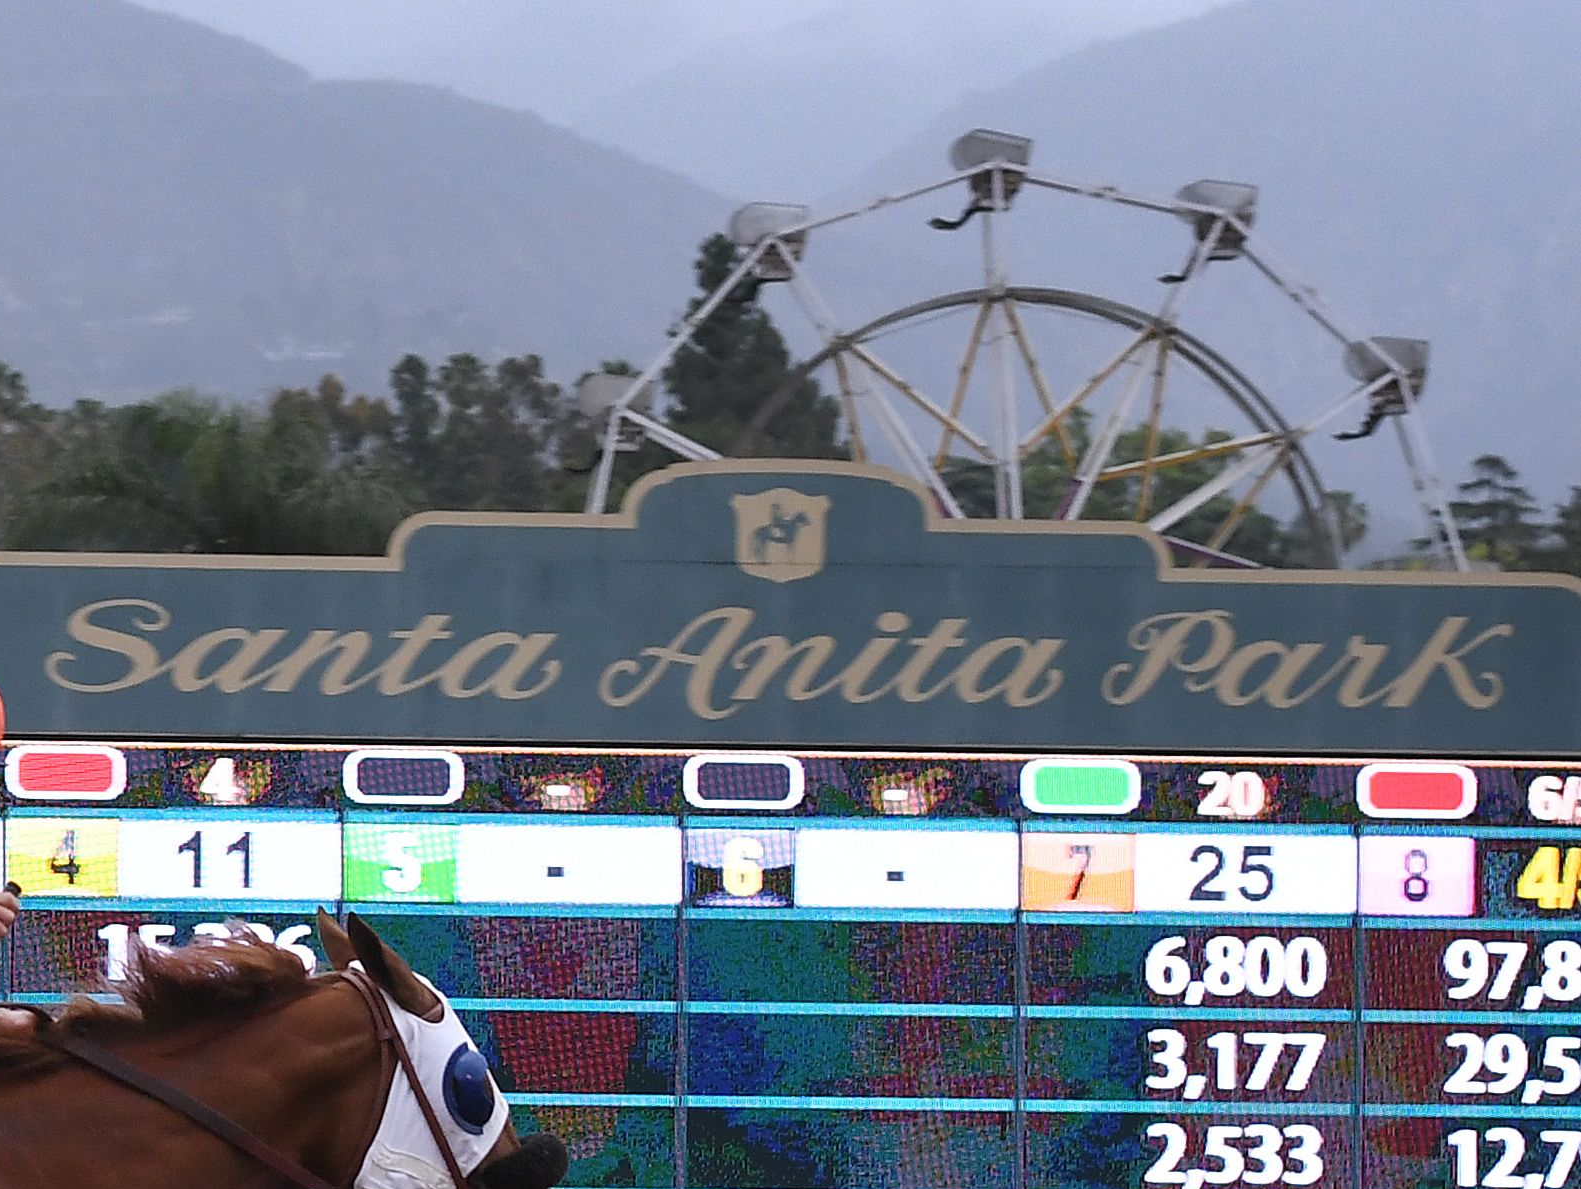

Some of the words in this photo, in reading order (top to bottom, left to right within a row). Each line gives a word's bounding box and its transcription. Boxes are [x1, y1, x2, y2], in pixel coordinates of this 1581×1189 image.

[44, 599, 559, 698] Santa
[599, 606, 1064, 721] Anita
[1197, 771, 1265, 815] 20
[48, 829, 80, 884] 4
[178, 831, 251, 888] 11
[382, 832, 422, 893] 5
[723, 838, 764, 897] 6
[1068, 845, 1091, 900] 7
[1189, 845, 1274, 901] 25
[1404, 849, 1428, 901] 8
[1517, 847, 1581, 909] 4/
[1145, 936, 1327, 1005] 6,800
[1145, 1029, 1326, 1099] 3,177
